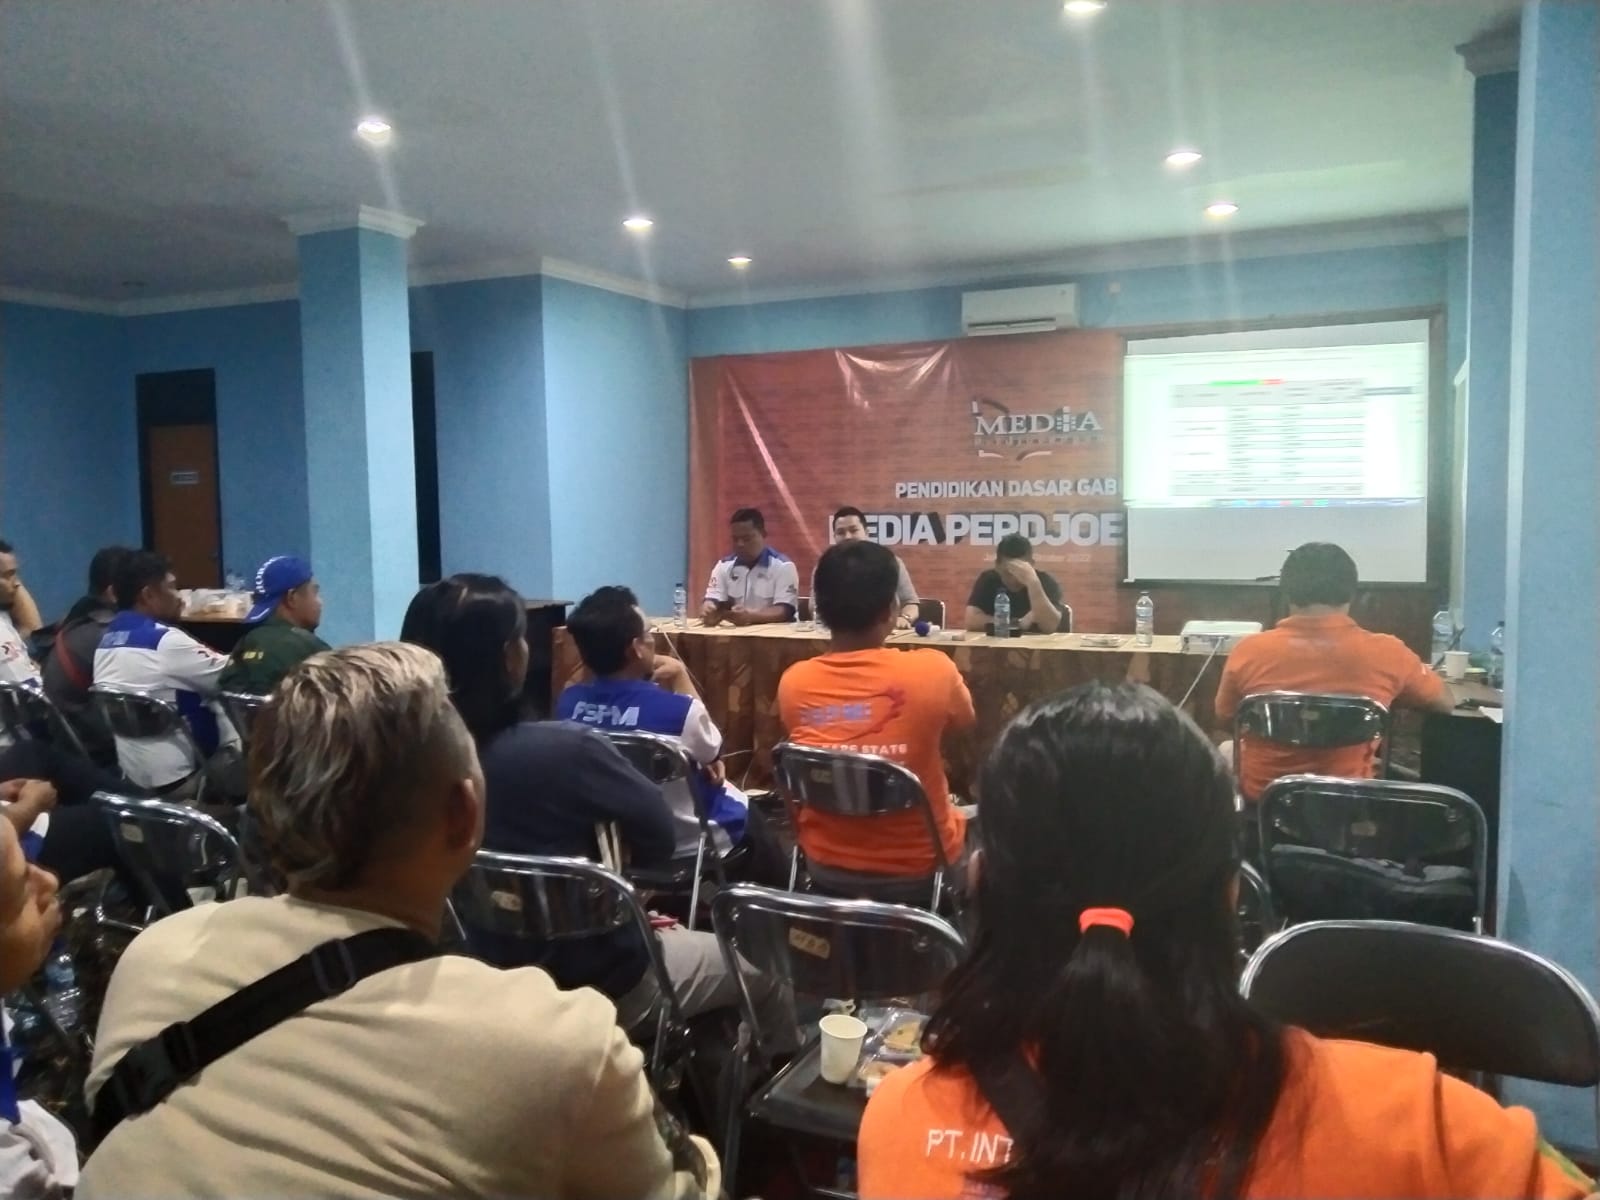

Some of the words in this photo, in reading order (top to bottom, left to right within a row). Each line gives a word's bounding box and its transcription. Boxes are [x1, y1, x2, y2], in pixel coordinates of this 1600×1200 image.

[973, 406, 1103, 435] MEDIA
[895, 480, 1004, 499] PENDIDIKAN
[1008, 479, 1072, 497] DASAR
[1077, 478, 1118, 496] GAB
